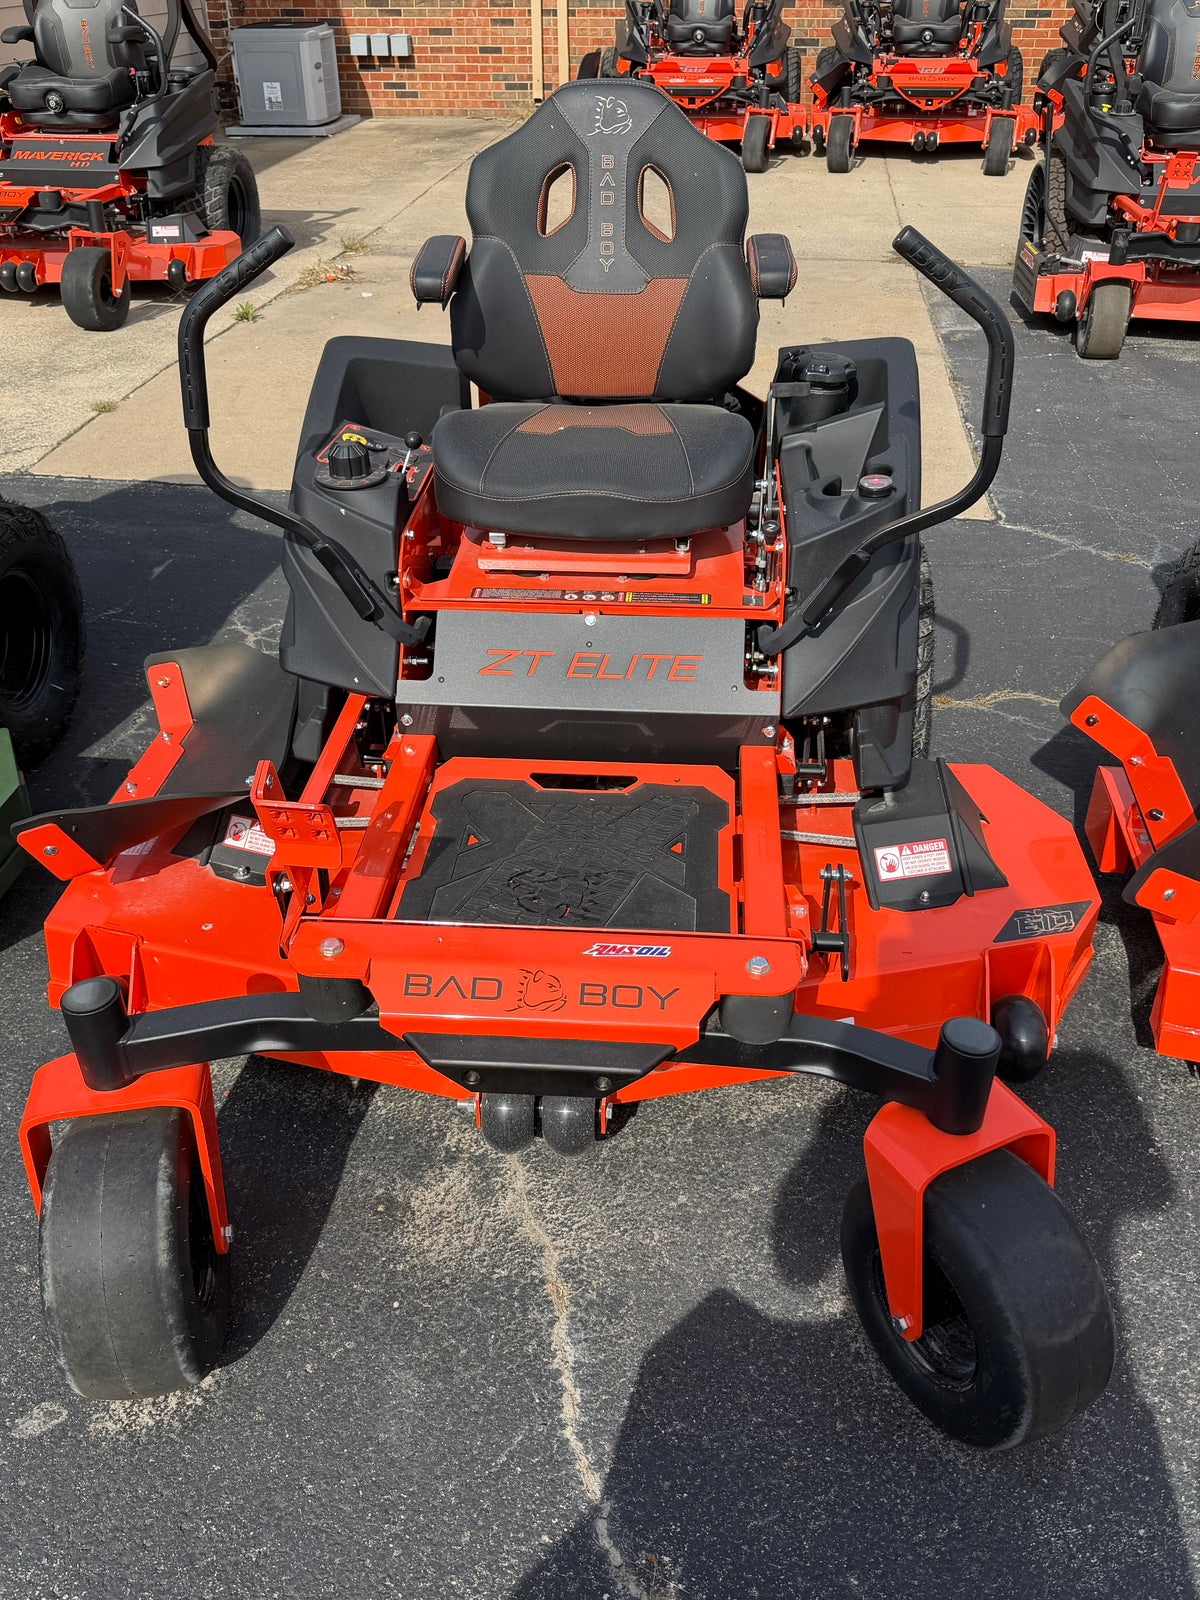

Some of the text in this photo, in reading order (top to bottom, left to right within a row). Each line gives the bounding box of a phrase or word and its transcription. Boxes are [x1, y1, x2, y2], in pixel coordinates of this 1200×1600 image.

[13, 150, 105, 161] MAVERICK
[599, 154, 615, 273] BAD BOY
[215, 240, 275, 297] BAD
[905, 241, 972, 294] BOY
[478, 649, 703, 681] ZT ELITE
[912, 841, 944, 853] DANGER
[583, 943, 672, 957] AMSOIL
[403, 973, 680, 1010] BAD BOY
